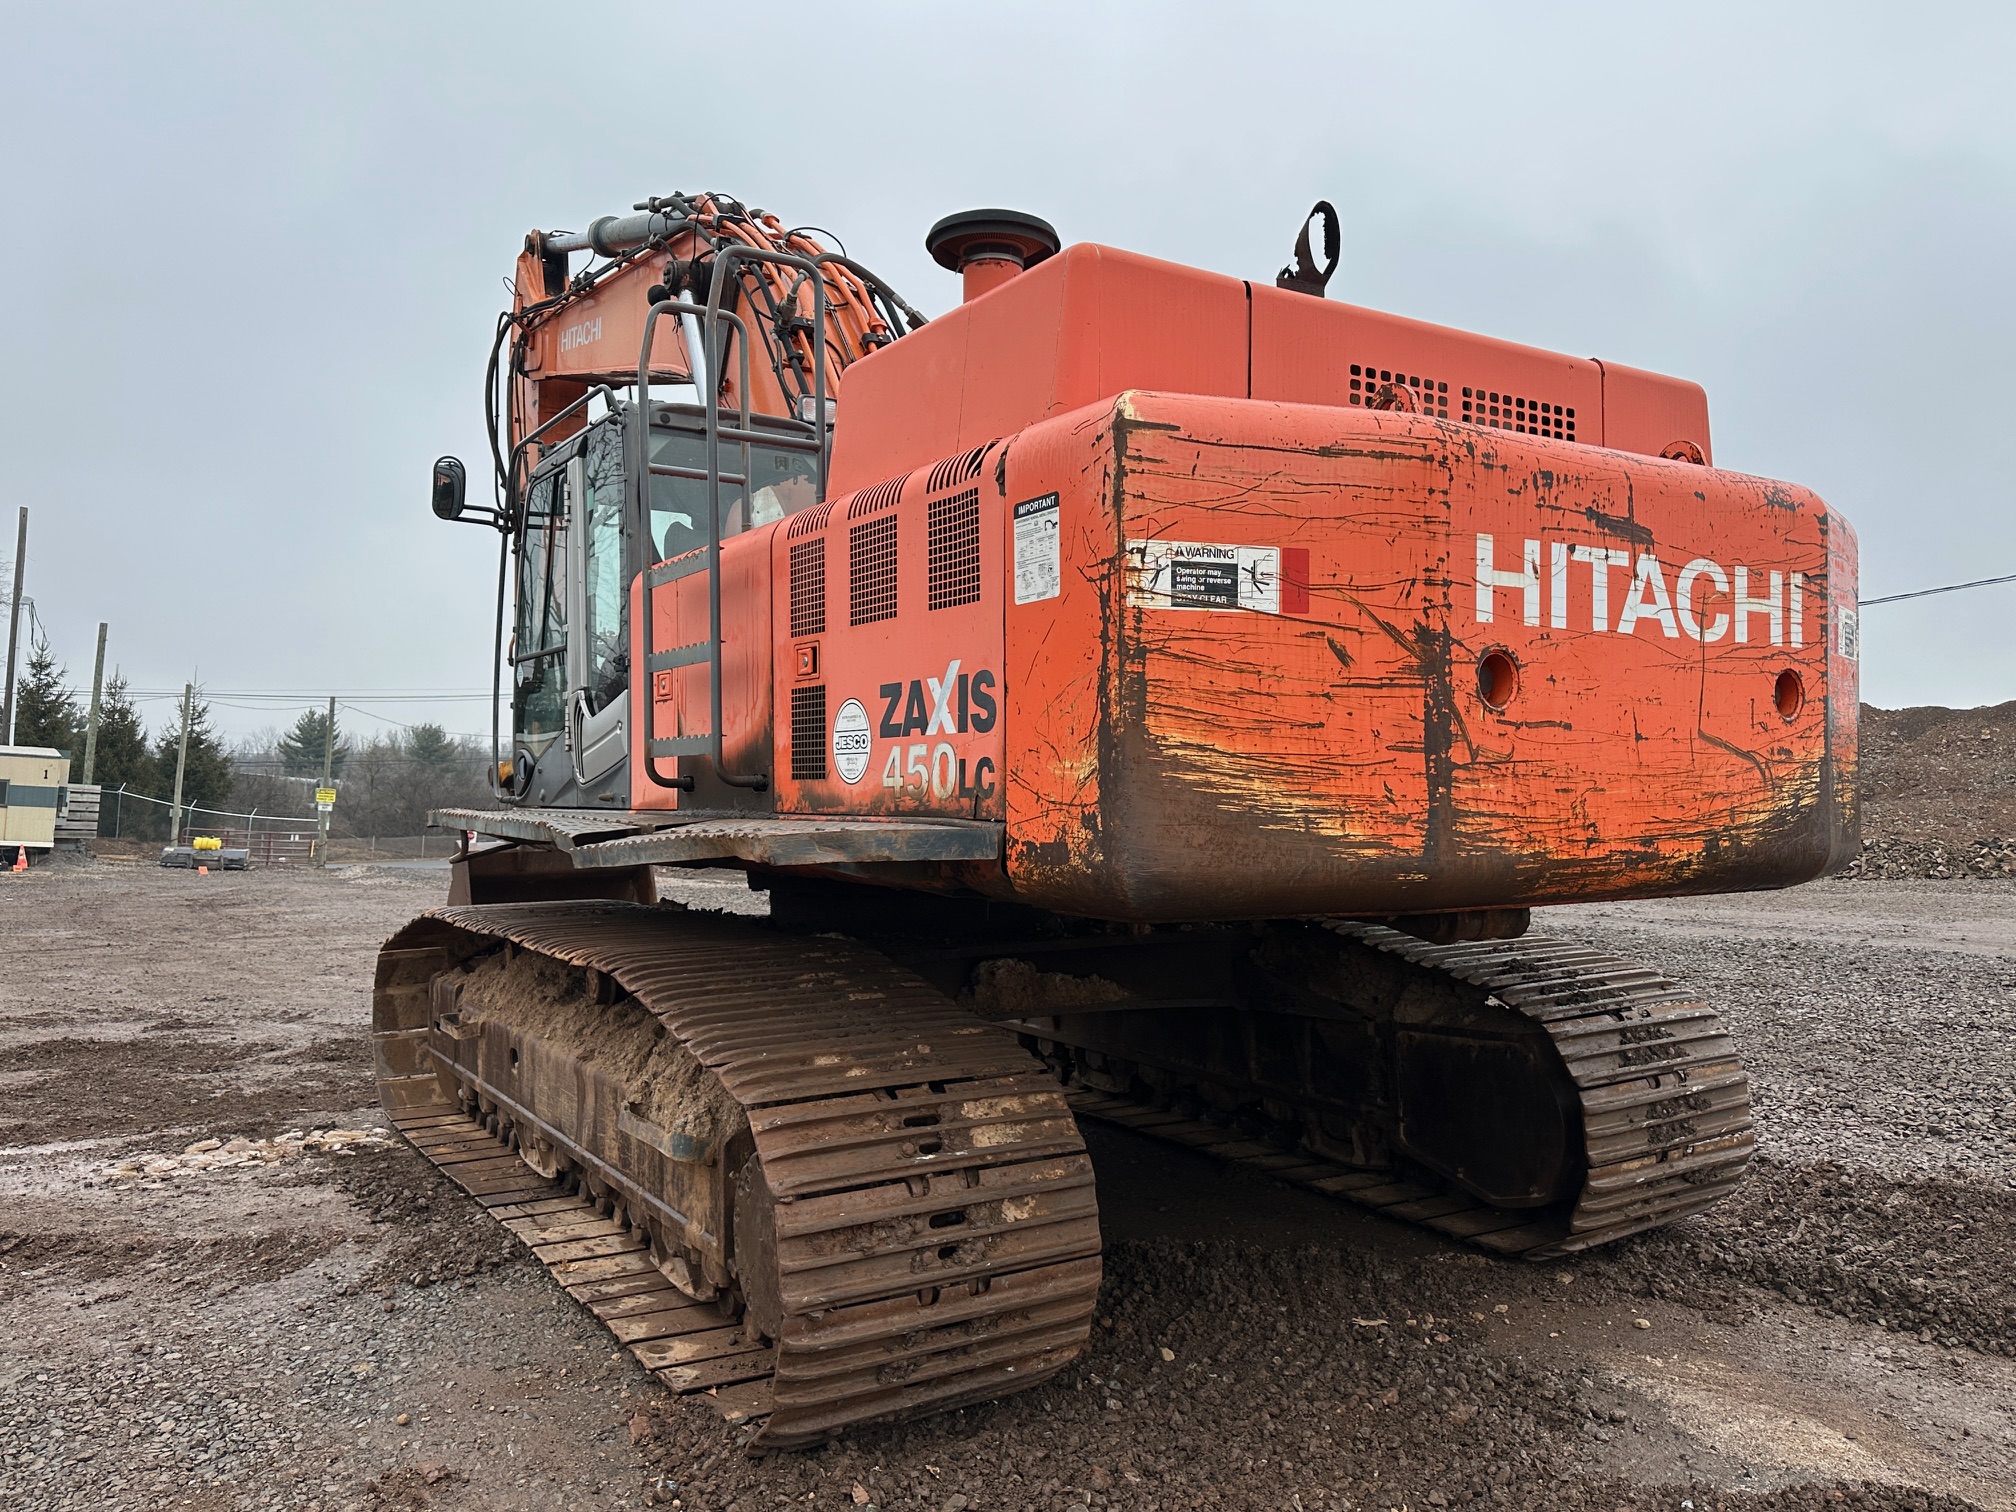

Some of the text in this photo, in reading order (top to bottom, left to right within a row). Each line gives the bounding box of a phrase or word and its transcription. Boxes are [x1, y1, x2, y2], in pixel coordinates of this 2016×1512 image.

[560, 316, 602, 353] HITACHI
[1018, 495, 1056, 515] IMPORTANT
[1185, 546, 1235, 560] WARNING
[1176, 567, 1222, 578] Operator may
[1176, 575, 1197, 584] swing
[1475, 532, 1803, 649] HITACHI
[879, 659, 997, 739] ZAXIS
[835, 734, 868, 751] JESCO
